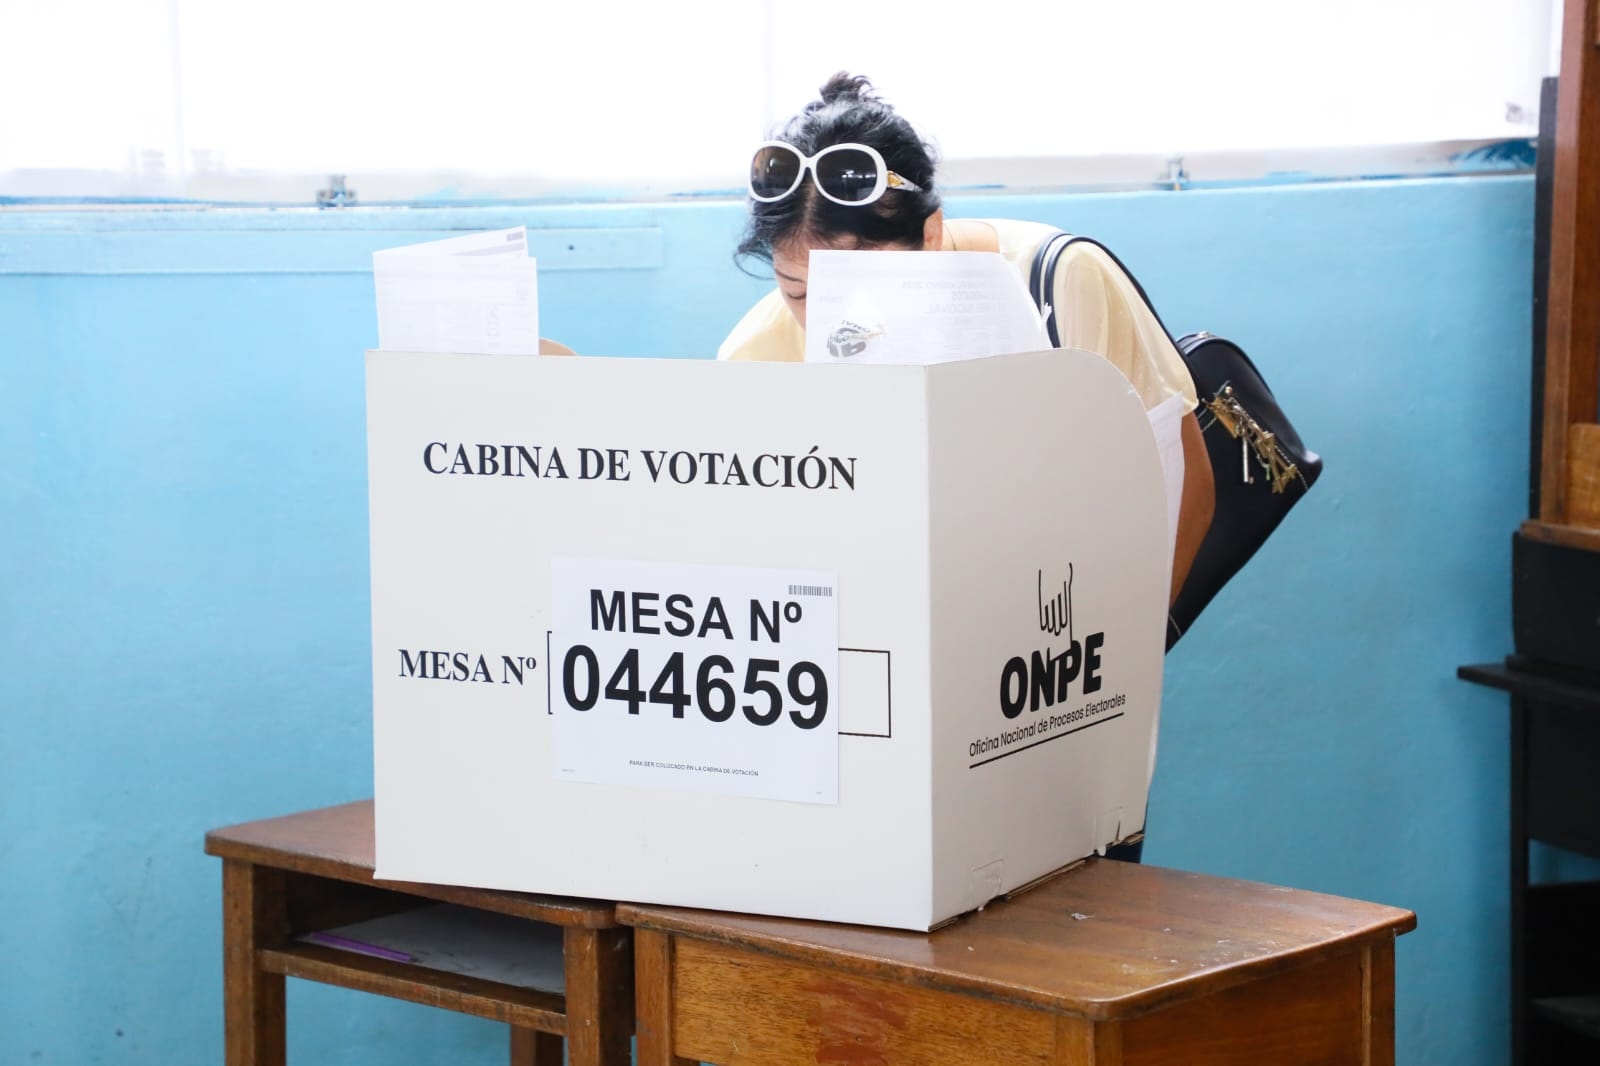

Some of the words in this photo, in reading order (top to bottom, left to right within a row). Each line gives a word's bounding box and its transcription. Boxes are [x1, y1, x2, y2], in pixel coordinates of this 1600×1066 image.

[423, 442, 569, 480] CABINA
[577, 448, 631, 482] DE
[640, 445, 857, 491] VOTACIÓN
[590, 589, 734, 640] MESA
[750, 599, 802, 643] Nº
[398, 649, 494, 685] MESA
[501, 655, 537, 685] Nº
[562, 644, 829, 730] 044659
[1000, 632, 1104, 719] ONPE
[969, 737, 999, 757] Oficina
[1000, 721, 1036, 747] Nacional
[1037, 718, 1048, 734] de
[1049, 708, 1084, 730] Procesos
[1085, 694, 1126, 718] Electorales
[655, 762, 685, 770] COLOCADO
